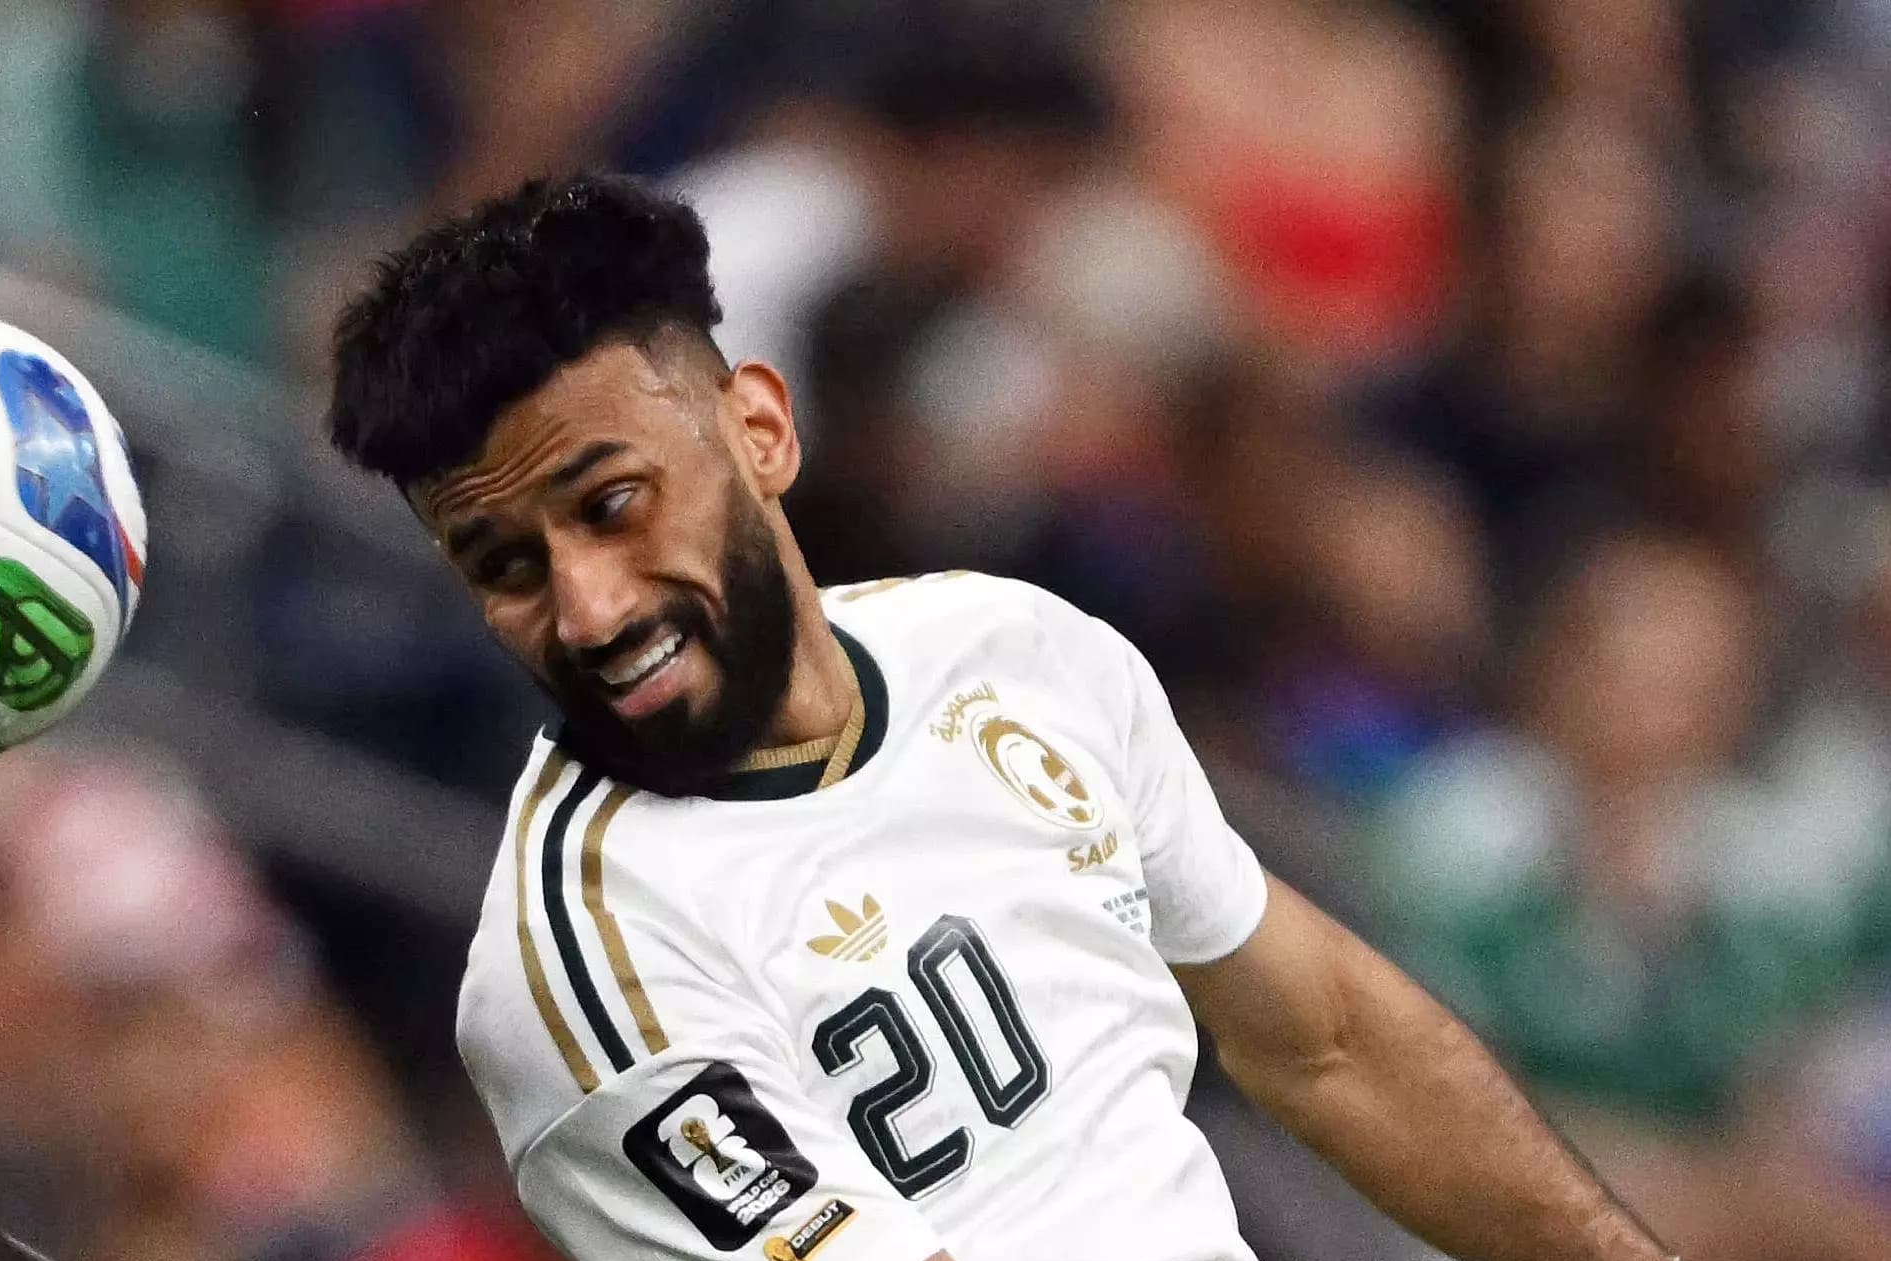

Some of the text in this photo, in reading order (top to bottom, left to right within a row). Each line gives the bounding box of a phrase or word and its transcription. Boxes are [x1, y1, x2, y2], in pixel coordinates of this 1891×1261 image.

[812, 913, 1053, 1202] 20
[723, 1164, 752, 1187] FIFA
[736, 1179, 791, 1226] 2026
[791, 1202, 840, 1249] DEBUT
